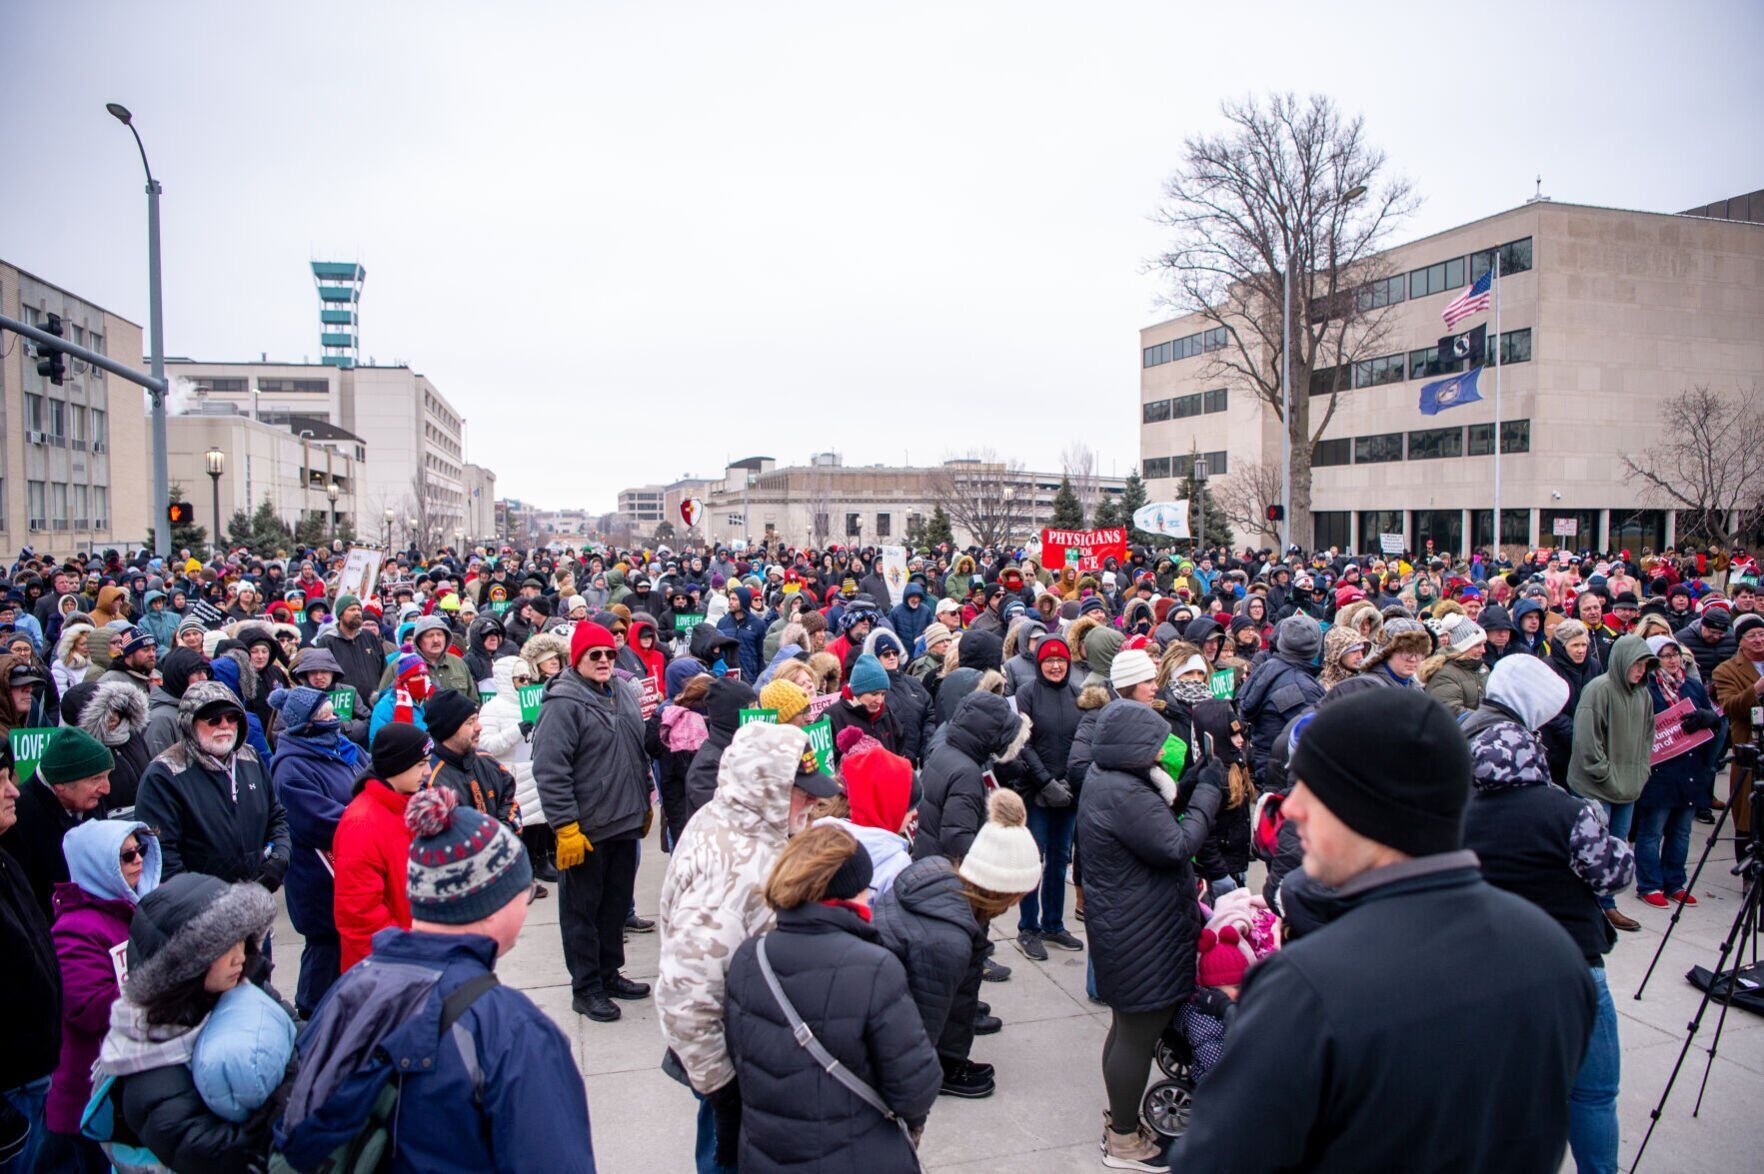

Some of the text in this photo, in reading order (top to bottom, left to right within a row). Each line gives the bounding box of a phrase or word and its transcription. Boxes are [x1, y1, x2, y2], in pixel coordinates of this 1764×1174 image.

[1048, 529, 1121, 547] PHYSICIANS
[1082, 547, 1093, 557] OR
[1084, 555, 1099, 570] FE
[676, 616, 690, 626] LOVE
[330, 692, 352, 709] IFE
[521, 688, 543, 708] LOV
[811, 699, 833, 712] TECT
[809, 724, 831, 753] OVE
[1655, 722, 1682, 740] univer
[1651, 743, 1664, 753] gn
[1664, 736, 1674, 746] of
